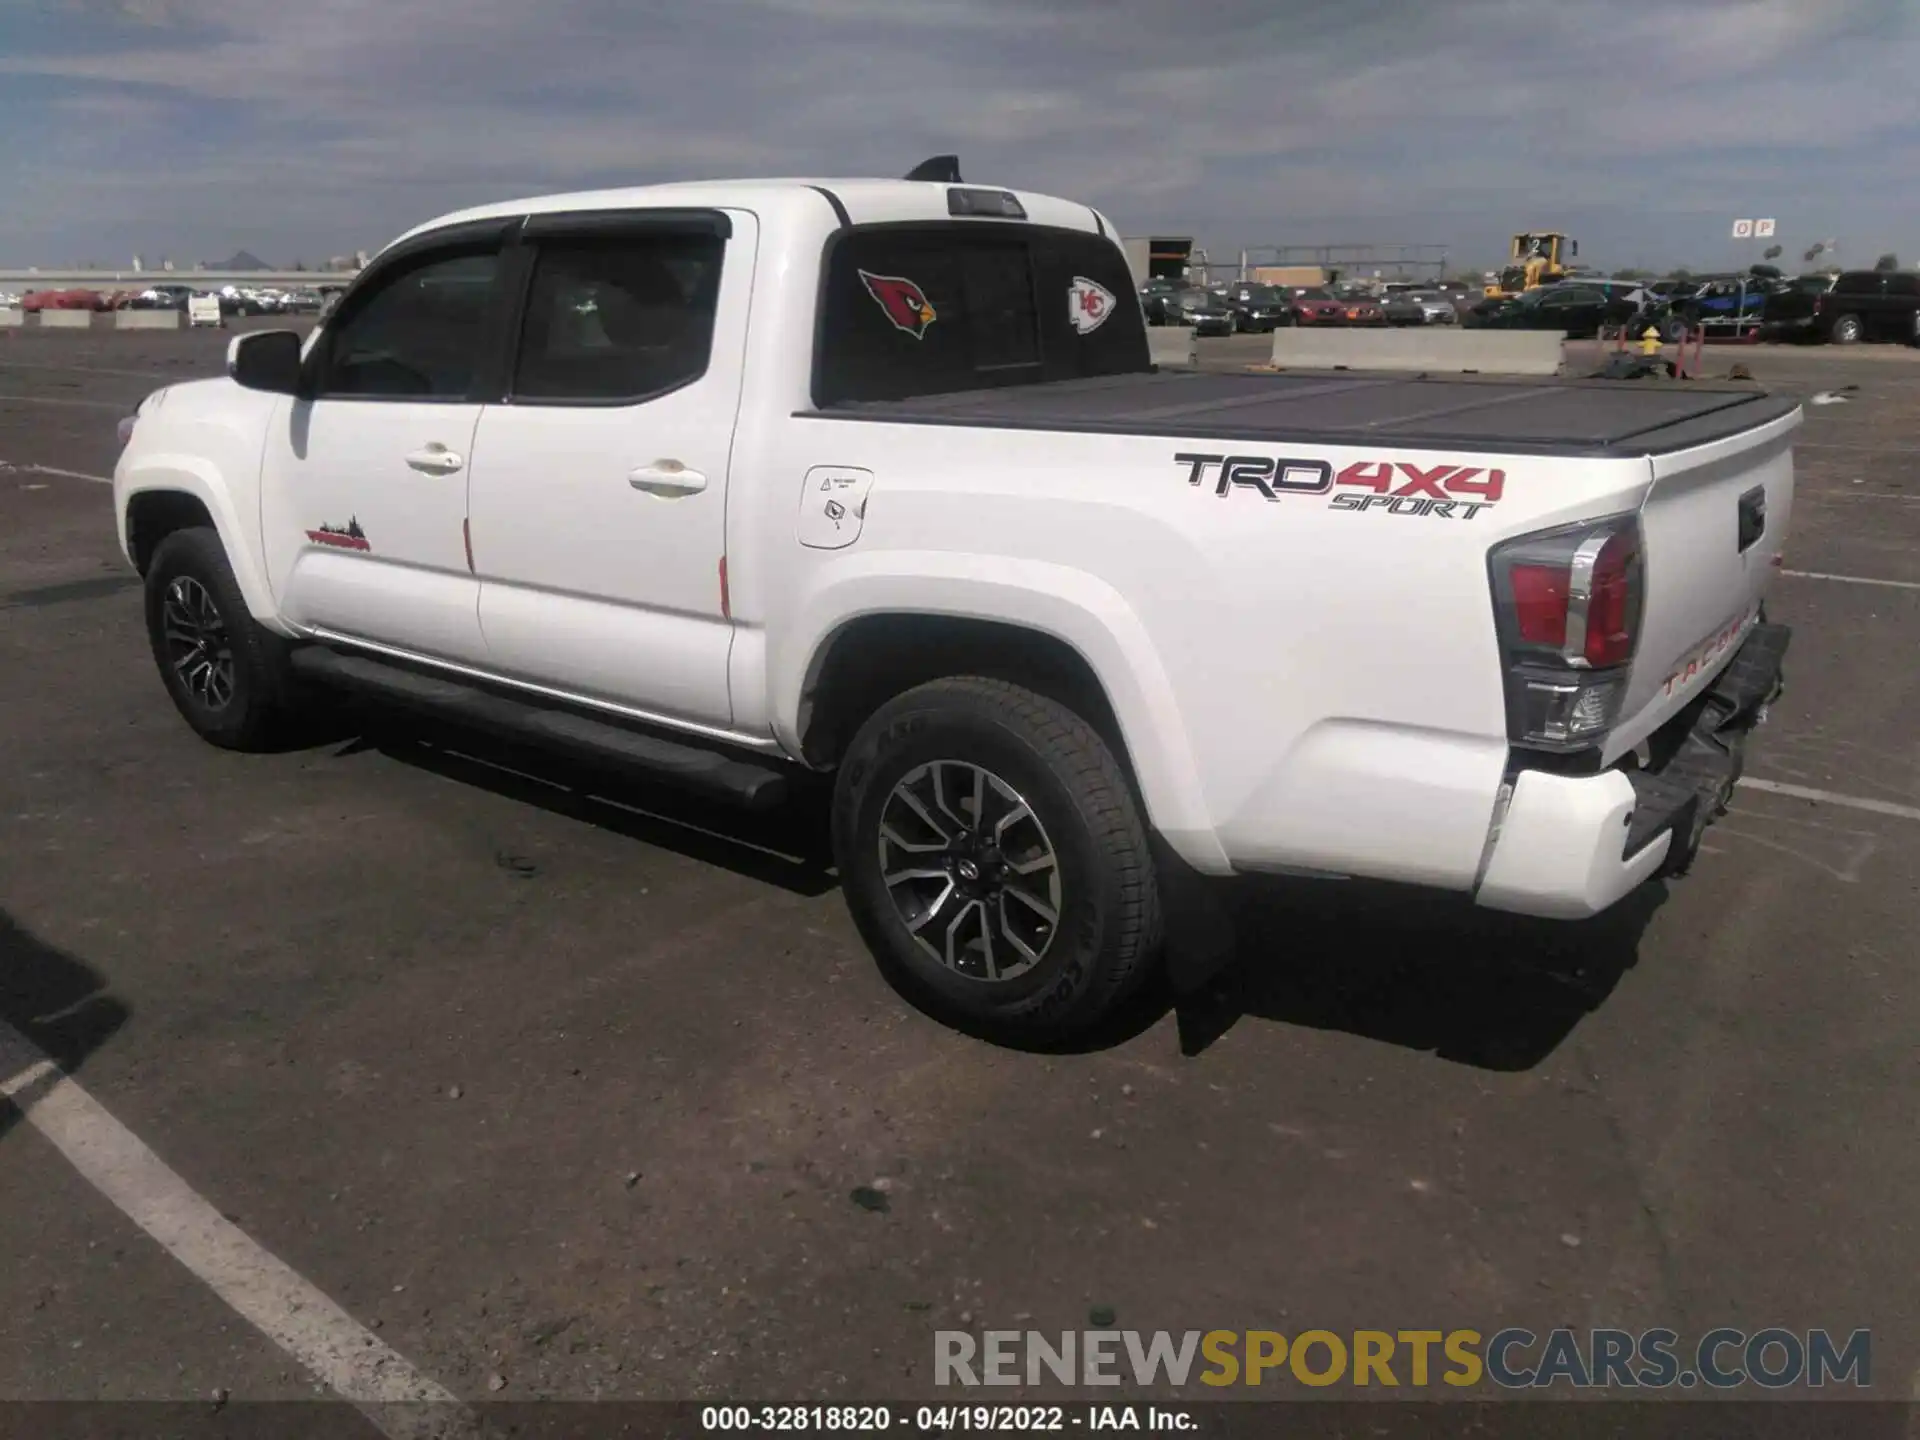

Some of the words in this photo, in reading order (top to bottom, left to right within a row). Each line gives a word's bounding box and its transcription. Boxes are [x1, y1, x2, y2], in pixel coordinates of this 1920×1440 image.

[1759, 221, 1770, 233] P
[1079, 288, 1105, 319] KC
[1174, 452, 1334, 503] TRD
[1327, 493, 1496, 520] SPORT
